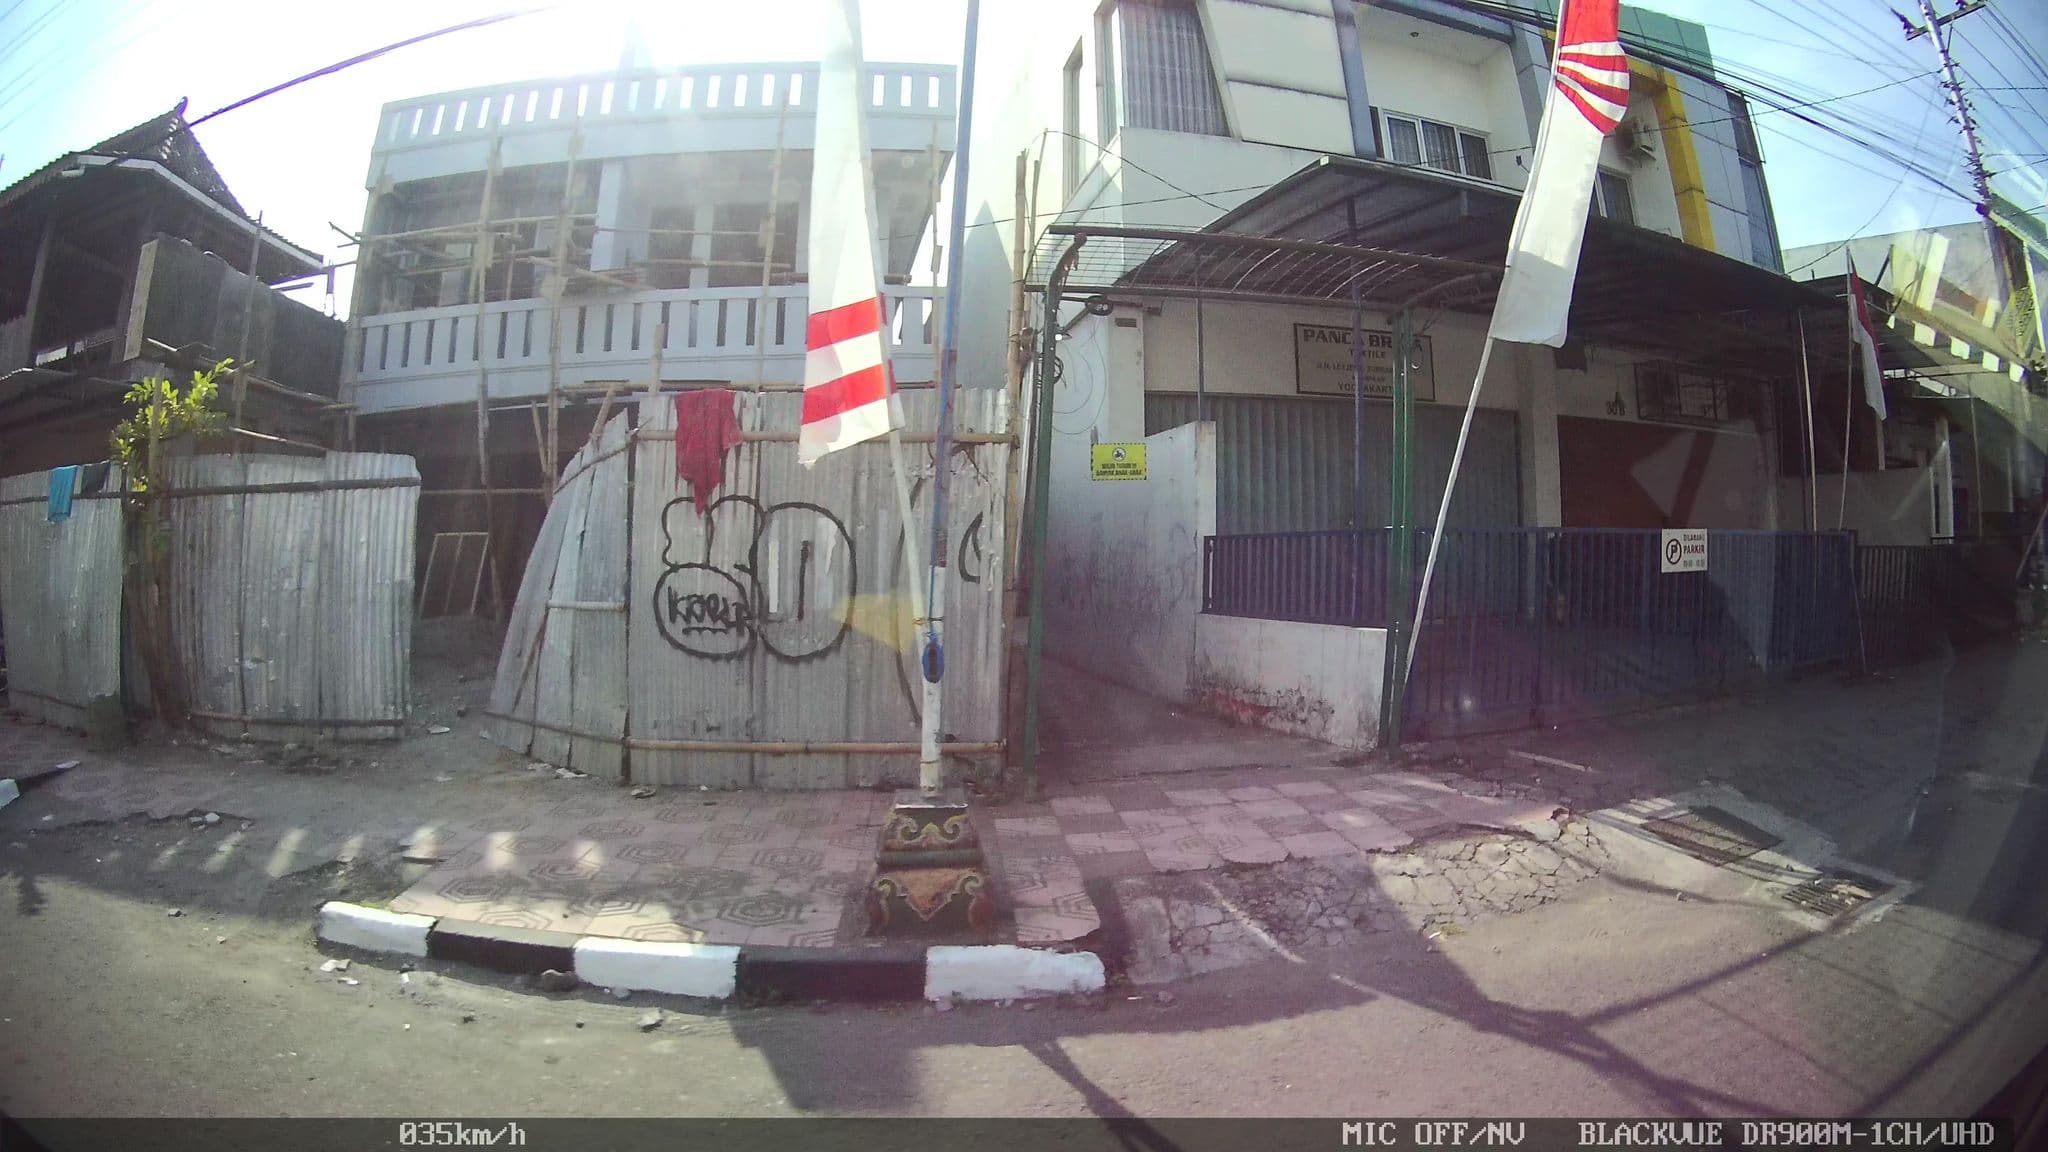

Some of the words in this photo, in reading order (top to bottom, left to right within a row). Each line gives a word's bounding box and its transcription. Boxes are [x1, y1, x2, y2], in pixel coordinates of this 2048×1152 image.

[1368, 334, 1423, 352] BRA
[1349, 348, 1387, 359] TTILE
[1683, 544, 1705, 554] PARKIR
